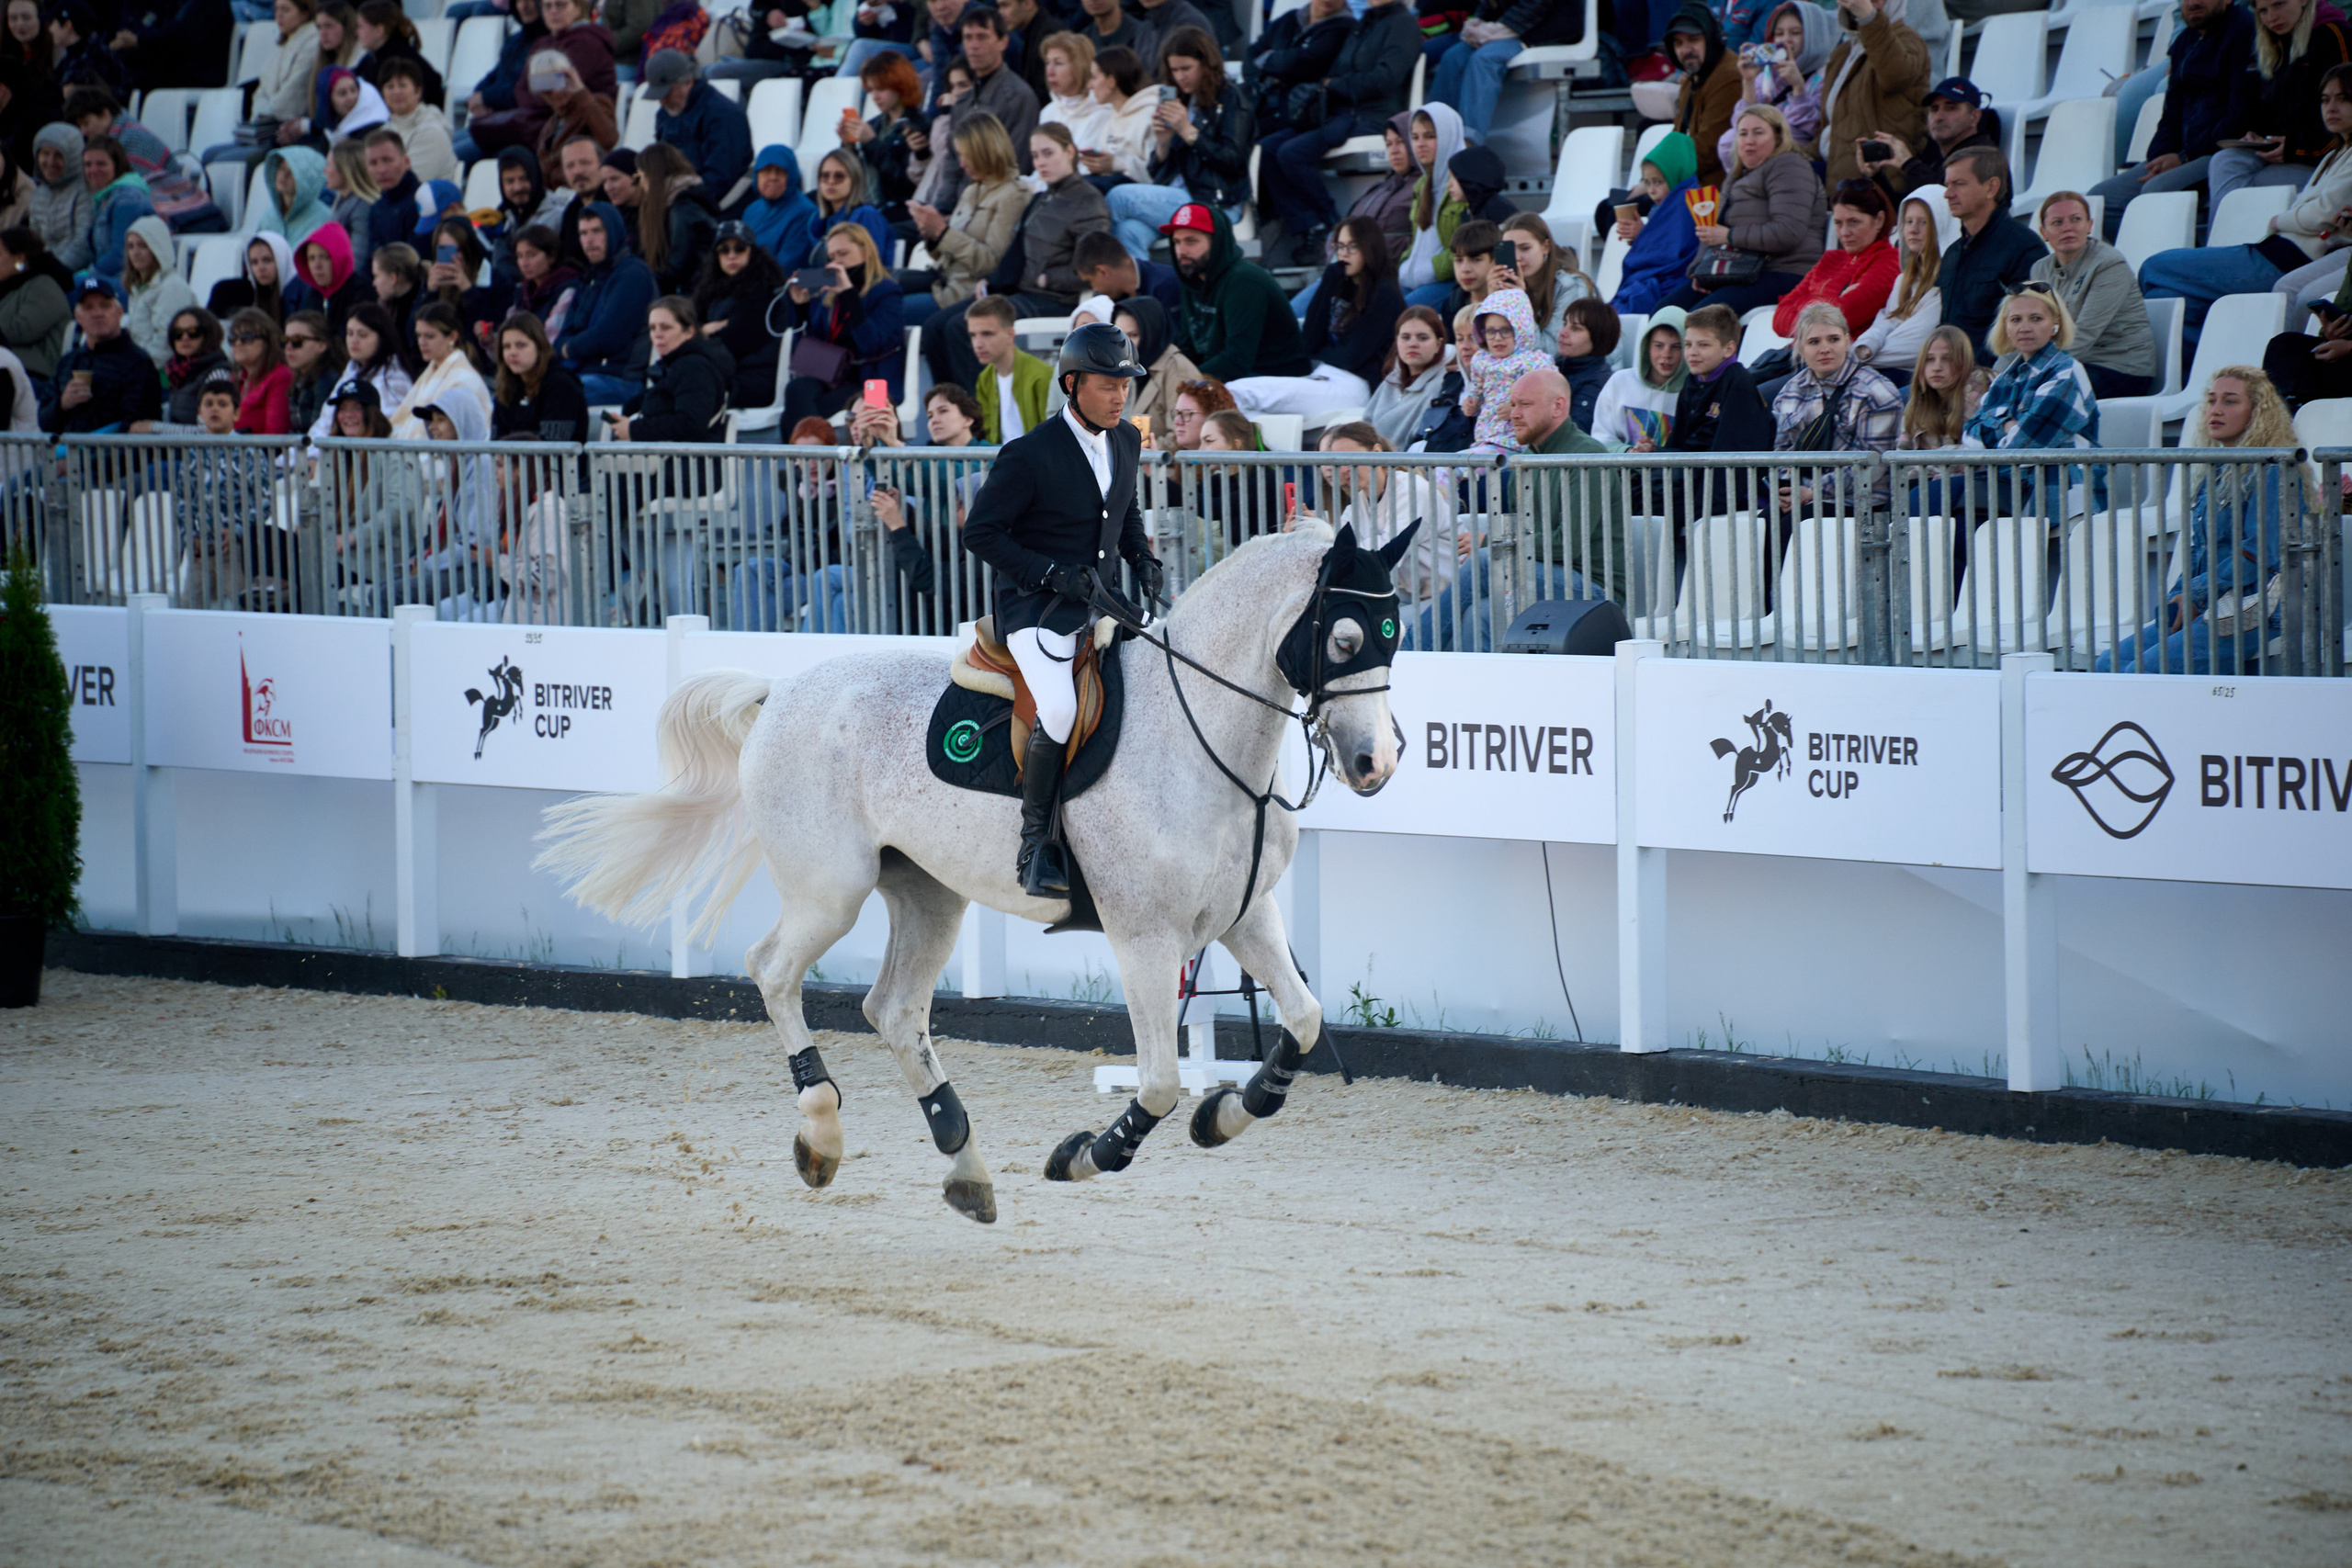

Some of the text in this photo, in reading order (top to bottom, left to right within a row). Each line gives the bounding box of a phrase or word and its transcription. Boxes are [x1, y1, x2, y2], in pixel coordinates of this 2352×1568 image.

[62, 665, 115, 706] VER
[535, 682, 612, 710] BITRIVER
[254, 718, 291, 738] ФКСМ
[535, 714, 571, 739] CUP
[1427, 721, 1593, 776] BITRIVER
[1808, 732, 1918, 766] BITRIVER
[1808, 769, 1860, 799] CUP
